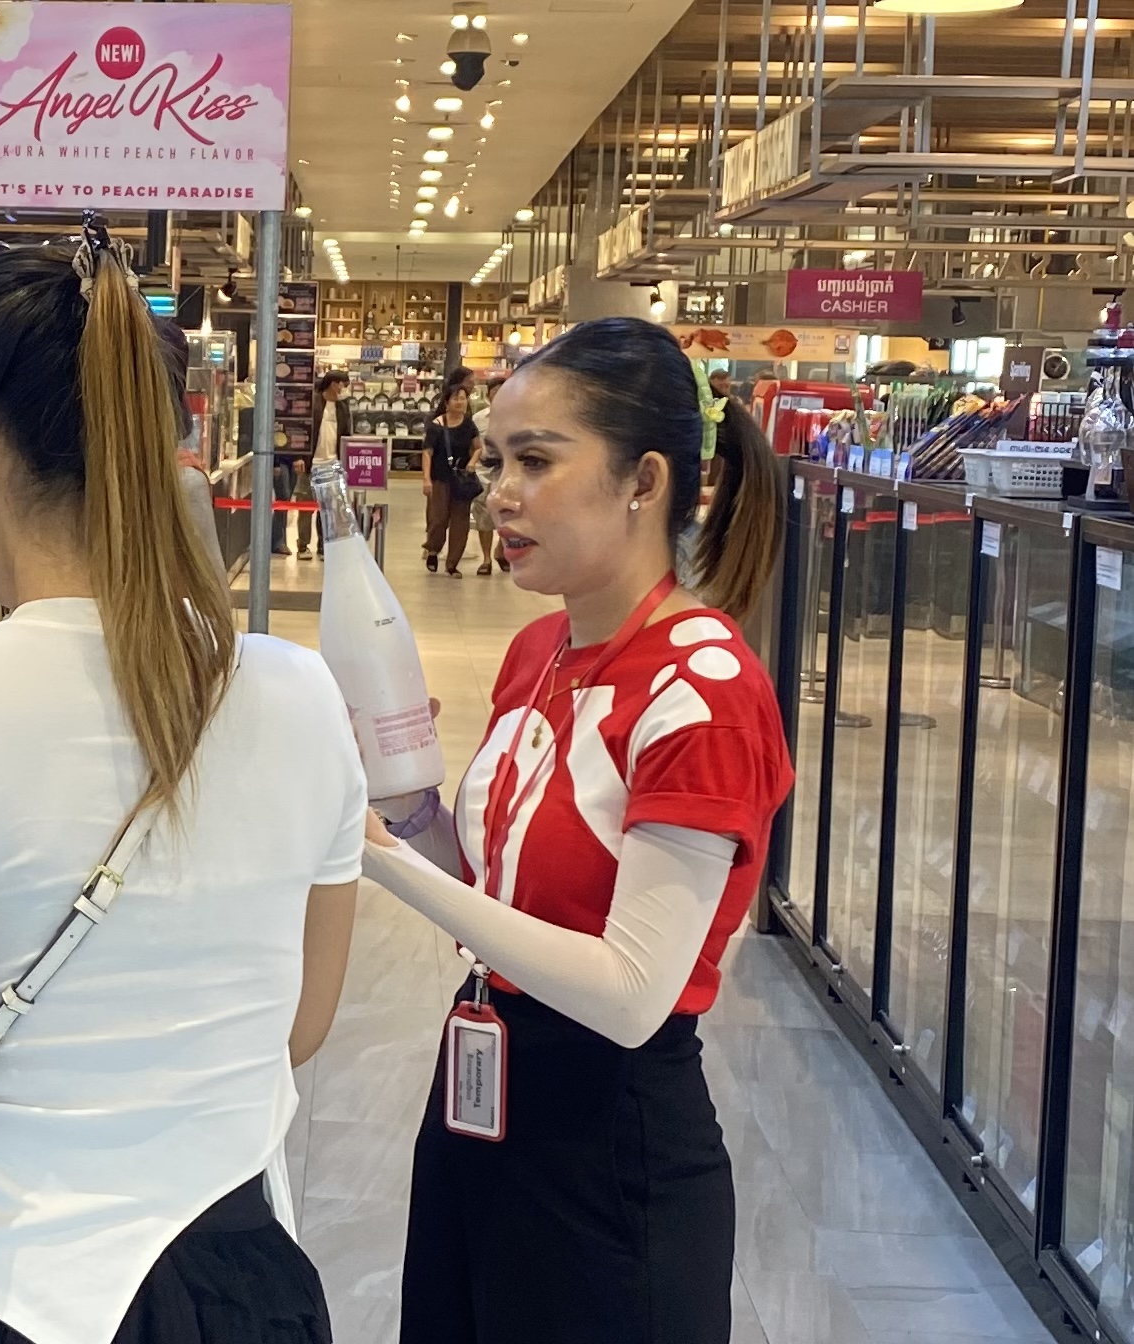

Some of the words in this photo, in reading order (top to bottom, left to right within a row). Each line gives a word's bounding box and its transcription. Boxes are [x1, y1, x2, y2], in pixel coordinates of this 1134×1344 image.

[100, 44, 140, 63] NEW!
[129, 53, 259, 146] Kiss
[59, 146, 110, 159] WHITE
[123, 147, 177, 160] PEACH
[189, 148, 254, 161] FLAVOR
[34, 184, 64, 196] FLY
[73, 185, 94, 196] TO
[102, 186, 158, 197] PEACH
[167, 187, 254, 198] PARADISE
[820, 299, 888, 313] CASHIER
[472, 1048, 485, 1109] Temporary
